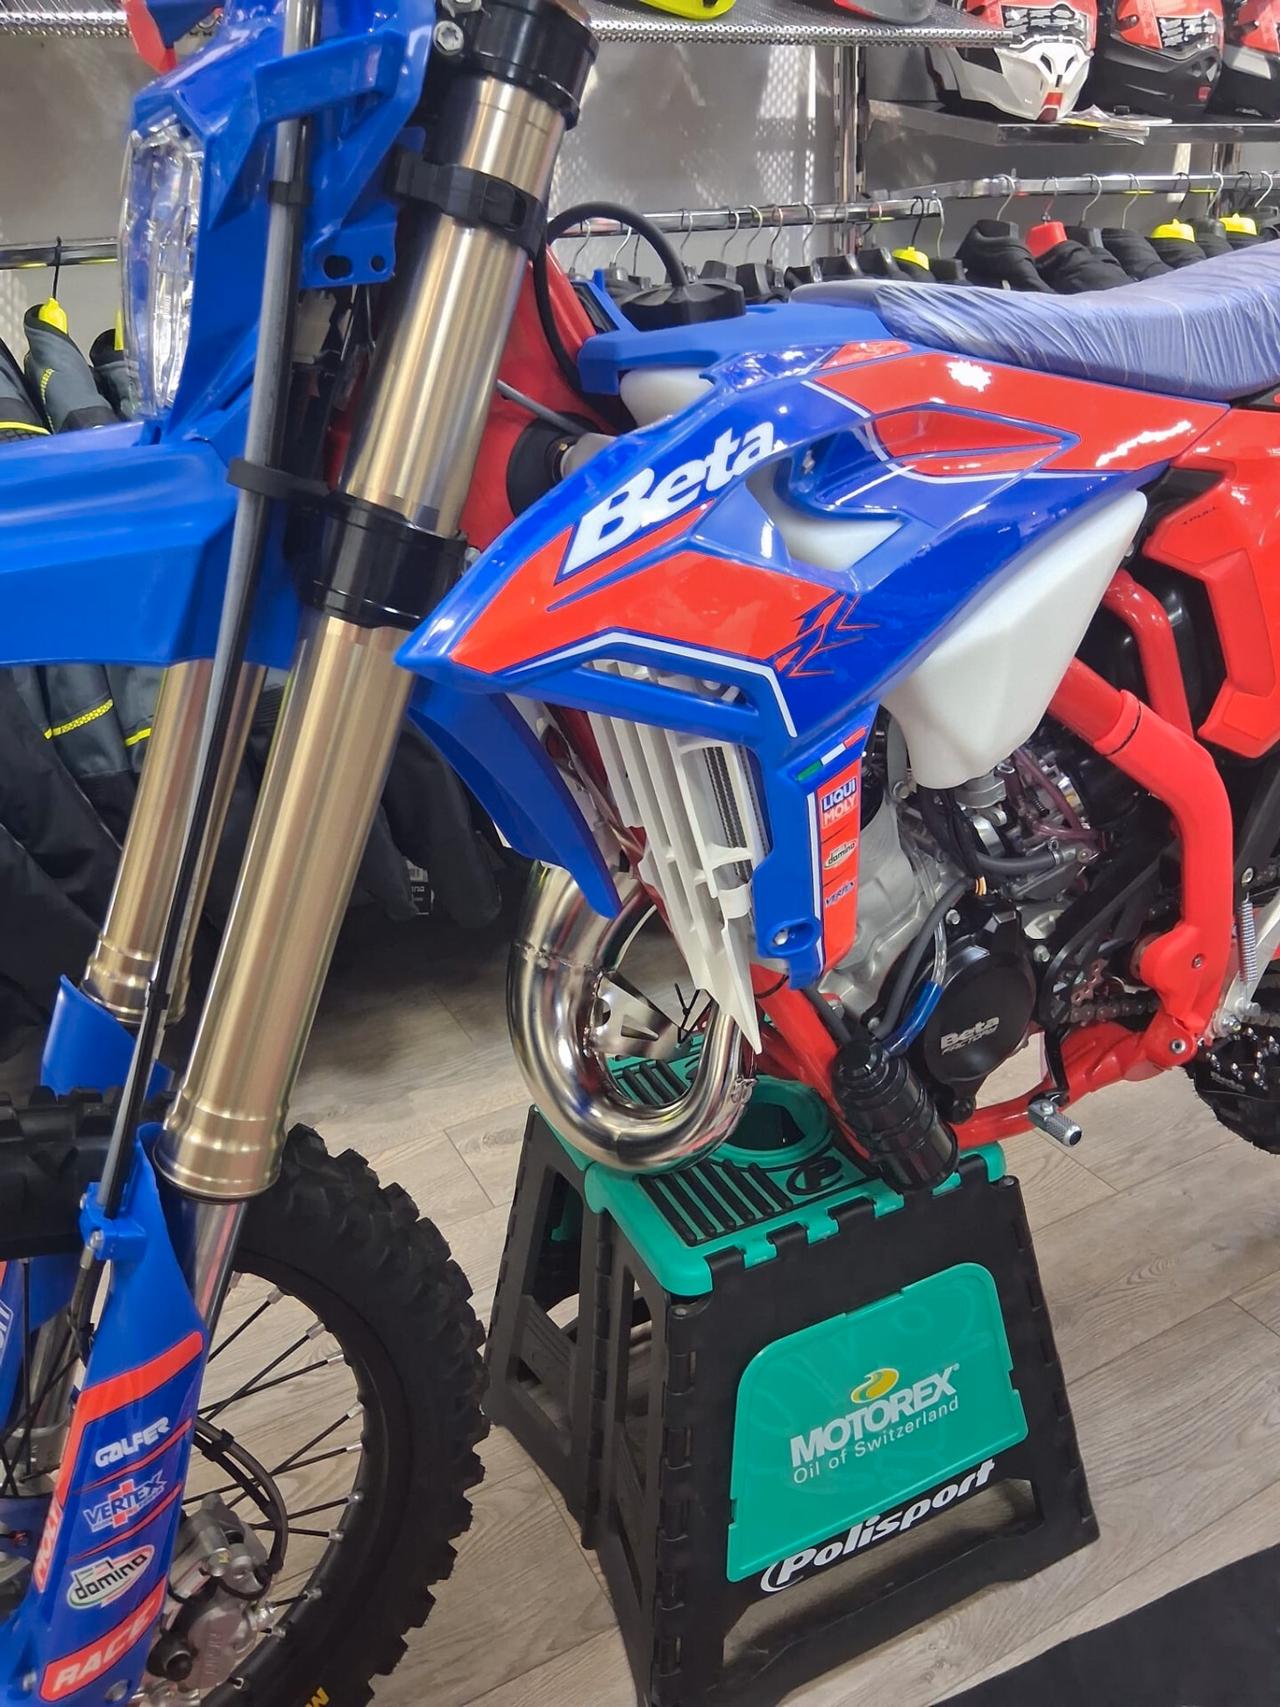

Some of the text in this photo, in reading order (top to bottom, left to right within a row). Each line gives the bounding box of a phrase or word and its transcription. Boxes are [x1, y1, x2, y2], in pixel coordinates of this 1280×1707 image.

[561, 421, 780, 576] Beta
[823, 779, 857, 812] LIQUI
[823, 796, 857, 829] MOLY
[940, 1016, 1000, 1050] Beta
[95, 1416, 171, 1467] GALFER
[790, 1365, 958, 1467] MOTOREX
[793, 1395, 960, 1484] Oil of Switzerland
[83, 1470, 167, 1530] VERTEX
[760, 1458, 996, 1592] Polisport
[74, 1553, 148, 1600] domino
[52, 1597, 156, 1692] RACE
